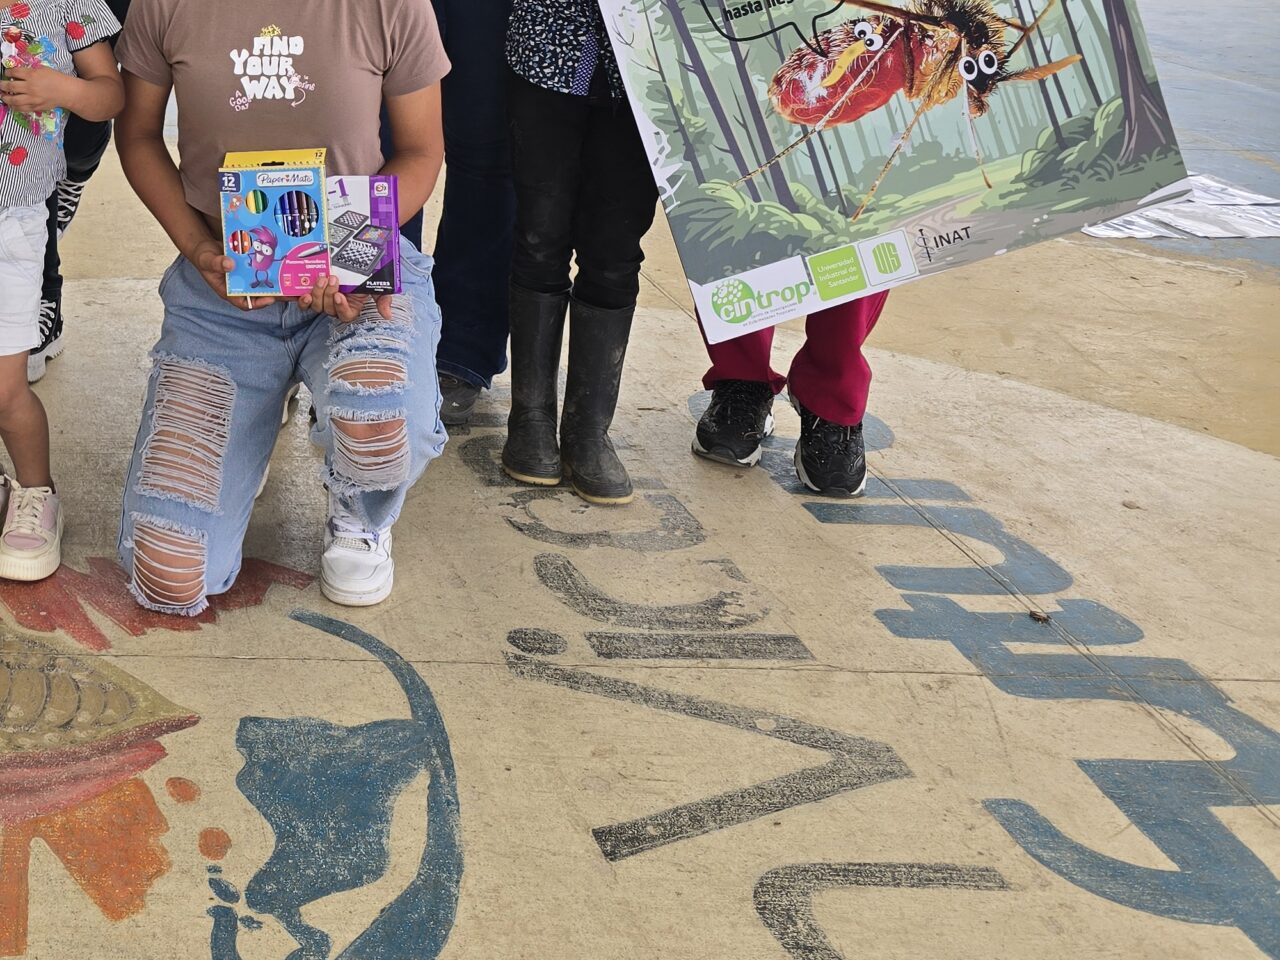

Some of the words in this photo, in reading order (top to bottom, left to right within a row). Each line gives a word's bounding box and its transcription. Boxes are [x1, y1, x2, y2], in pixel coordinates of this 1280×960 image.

[722, 0, 763, 22] hasta
[240, 75, 298, 99] WAY
[222, 176, 235, 187] 12
[257, 173, 285, 185] Paper
[289, 173, 313, 183] Mate
[933, 226, 970, 249] INAT
[817, 257, 854, 273] Universidad
[820, 269, 847, 282] Industrial
[828, 274, 859, 288] Santander
